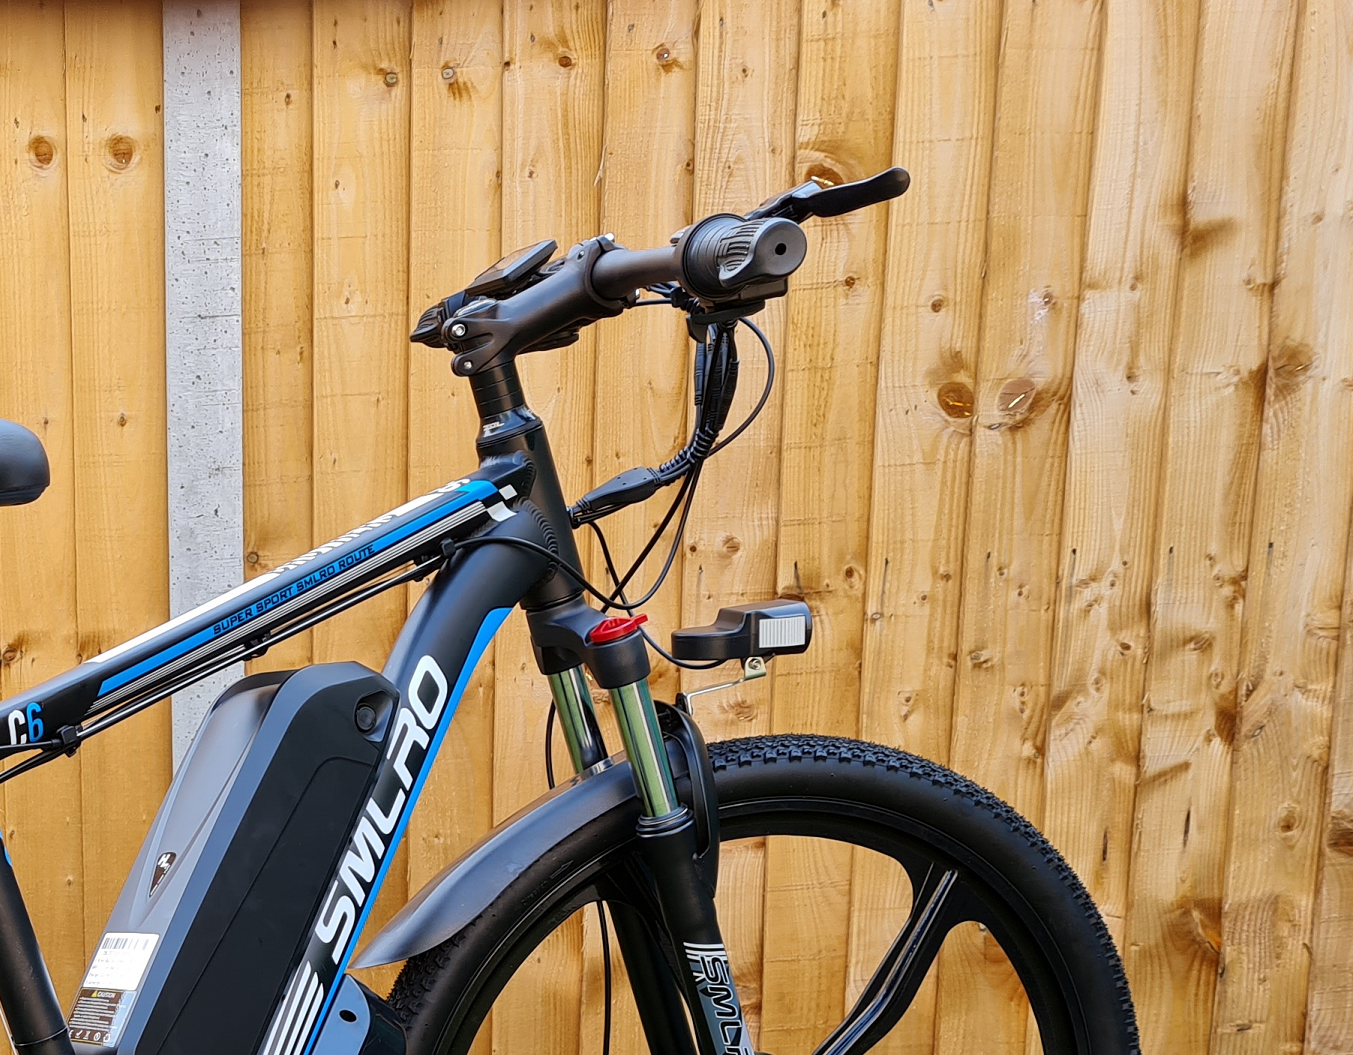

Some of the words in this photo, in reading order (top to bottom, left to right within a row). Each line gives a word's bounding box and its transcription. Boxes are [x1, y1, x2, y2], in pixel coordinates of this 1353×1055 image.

[213, 610, 253, 635] SUPER
[256, 587, 294, 612] SPORT
[338, 544, 376, 570] ROUTE
[8, 702, 44, 745] C6
[314, 655, 448, 965] SMLRO
